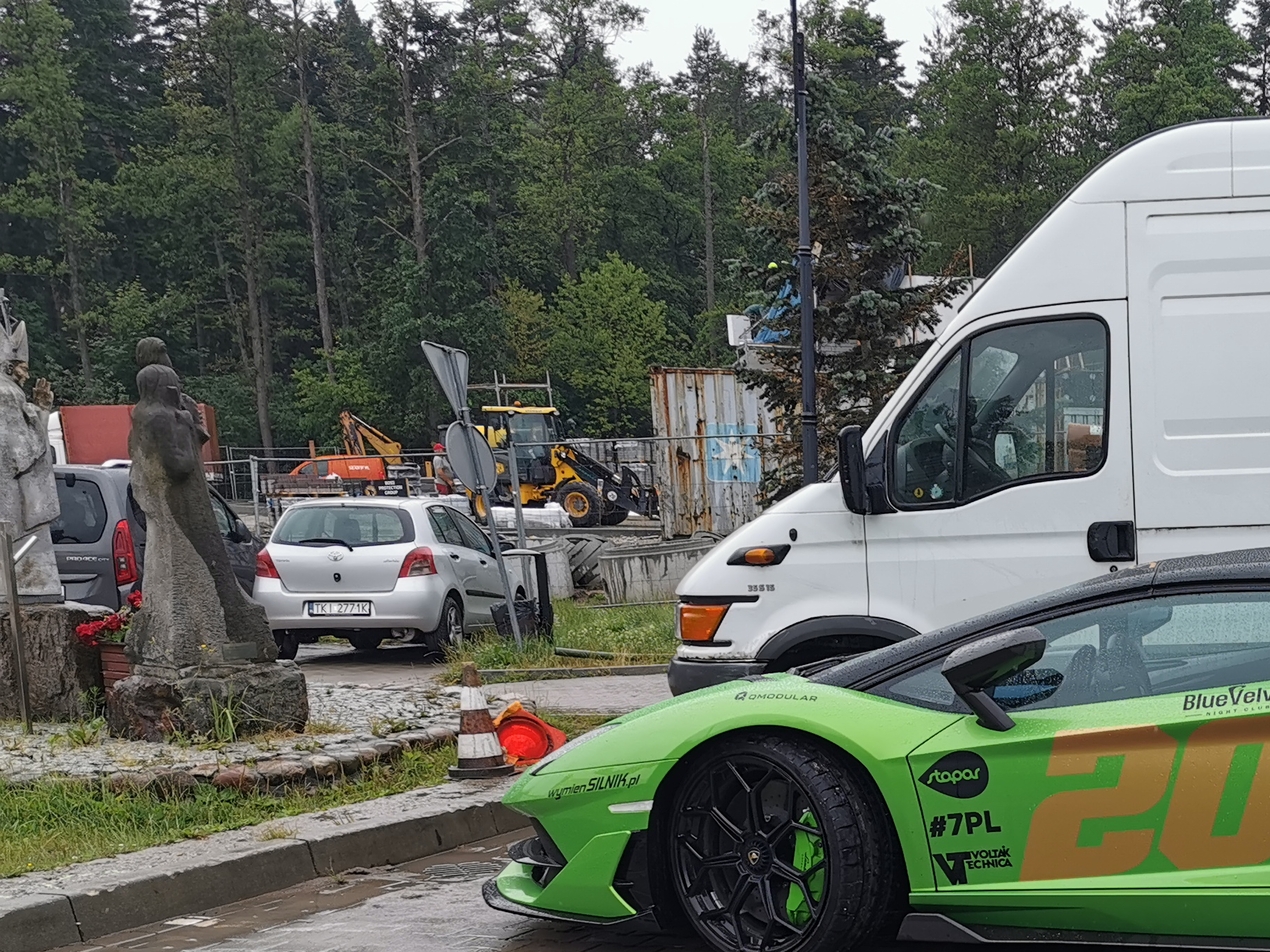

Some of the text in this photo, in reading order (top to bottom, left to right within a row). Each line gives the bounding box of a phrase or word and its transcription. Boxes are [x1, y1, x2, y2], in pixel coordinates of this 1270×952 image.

[1205, 704, 1270, 717] NIGHT CLUB
[929, 810, 1002, 838] #7PL
